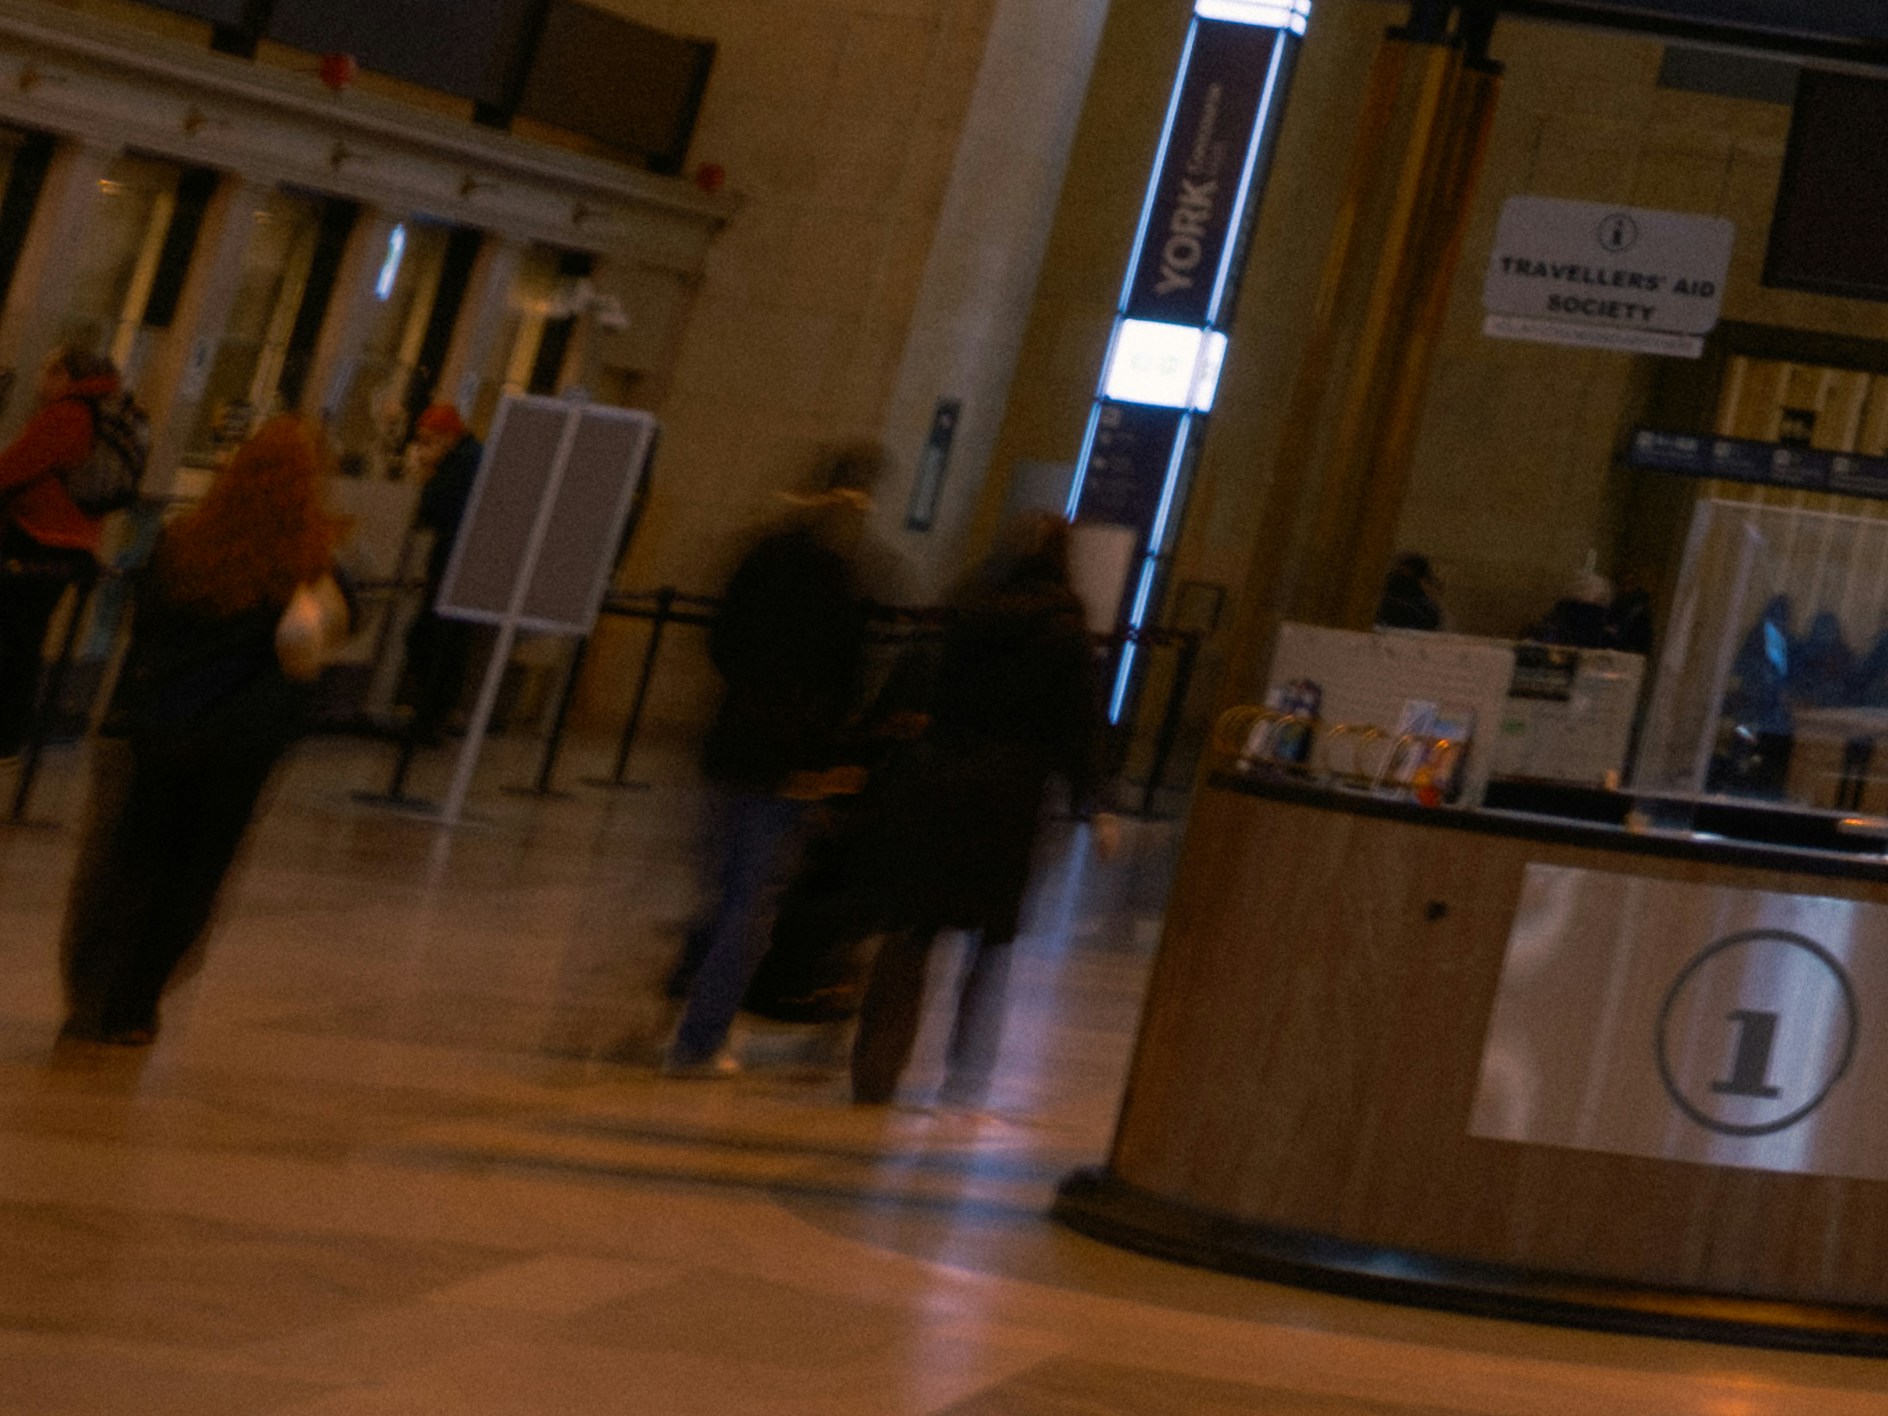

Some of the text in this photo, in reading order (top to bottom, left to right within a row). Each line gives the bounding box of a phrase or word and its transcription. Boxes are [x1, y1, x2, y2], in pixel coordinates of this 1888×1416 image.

[1155, 177, 1219, 296] YORK
[1501, 256, 1715, 298] TRAVELLERS' AID
[1548, 294, 1654, 321] SOCIETY
